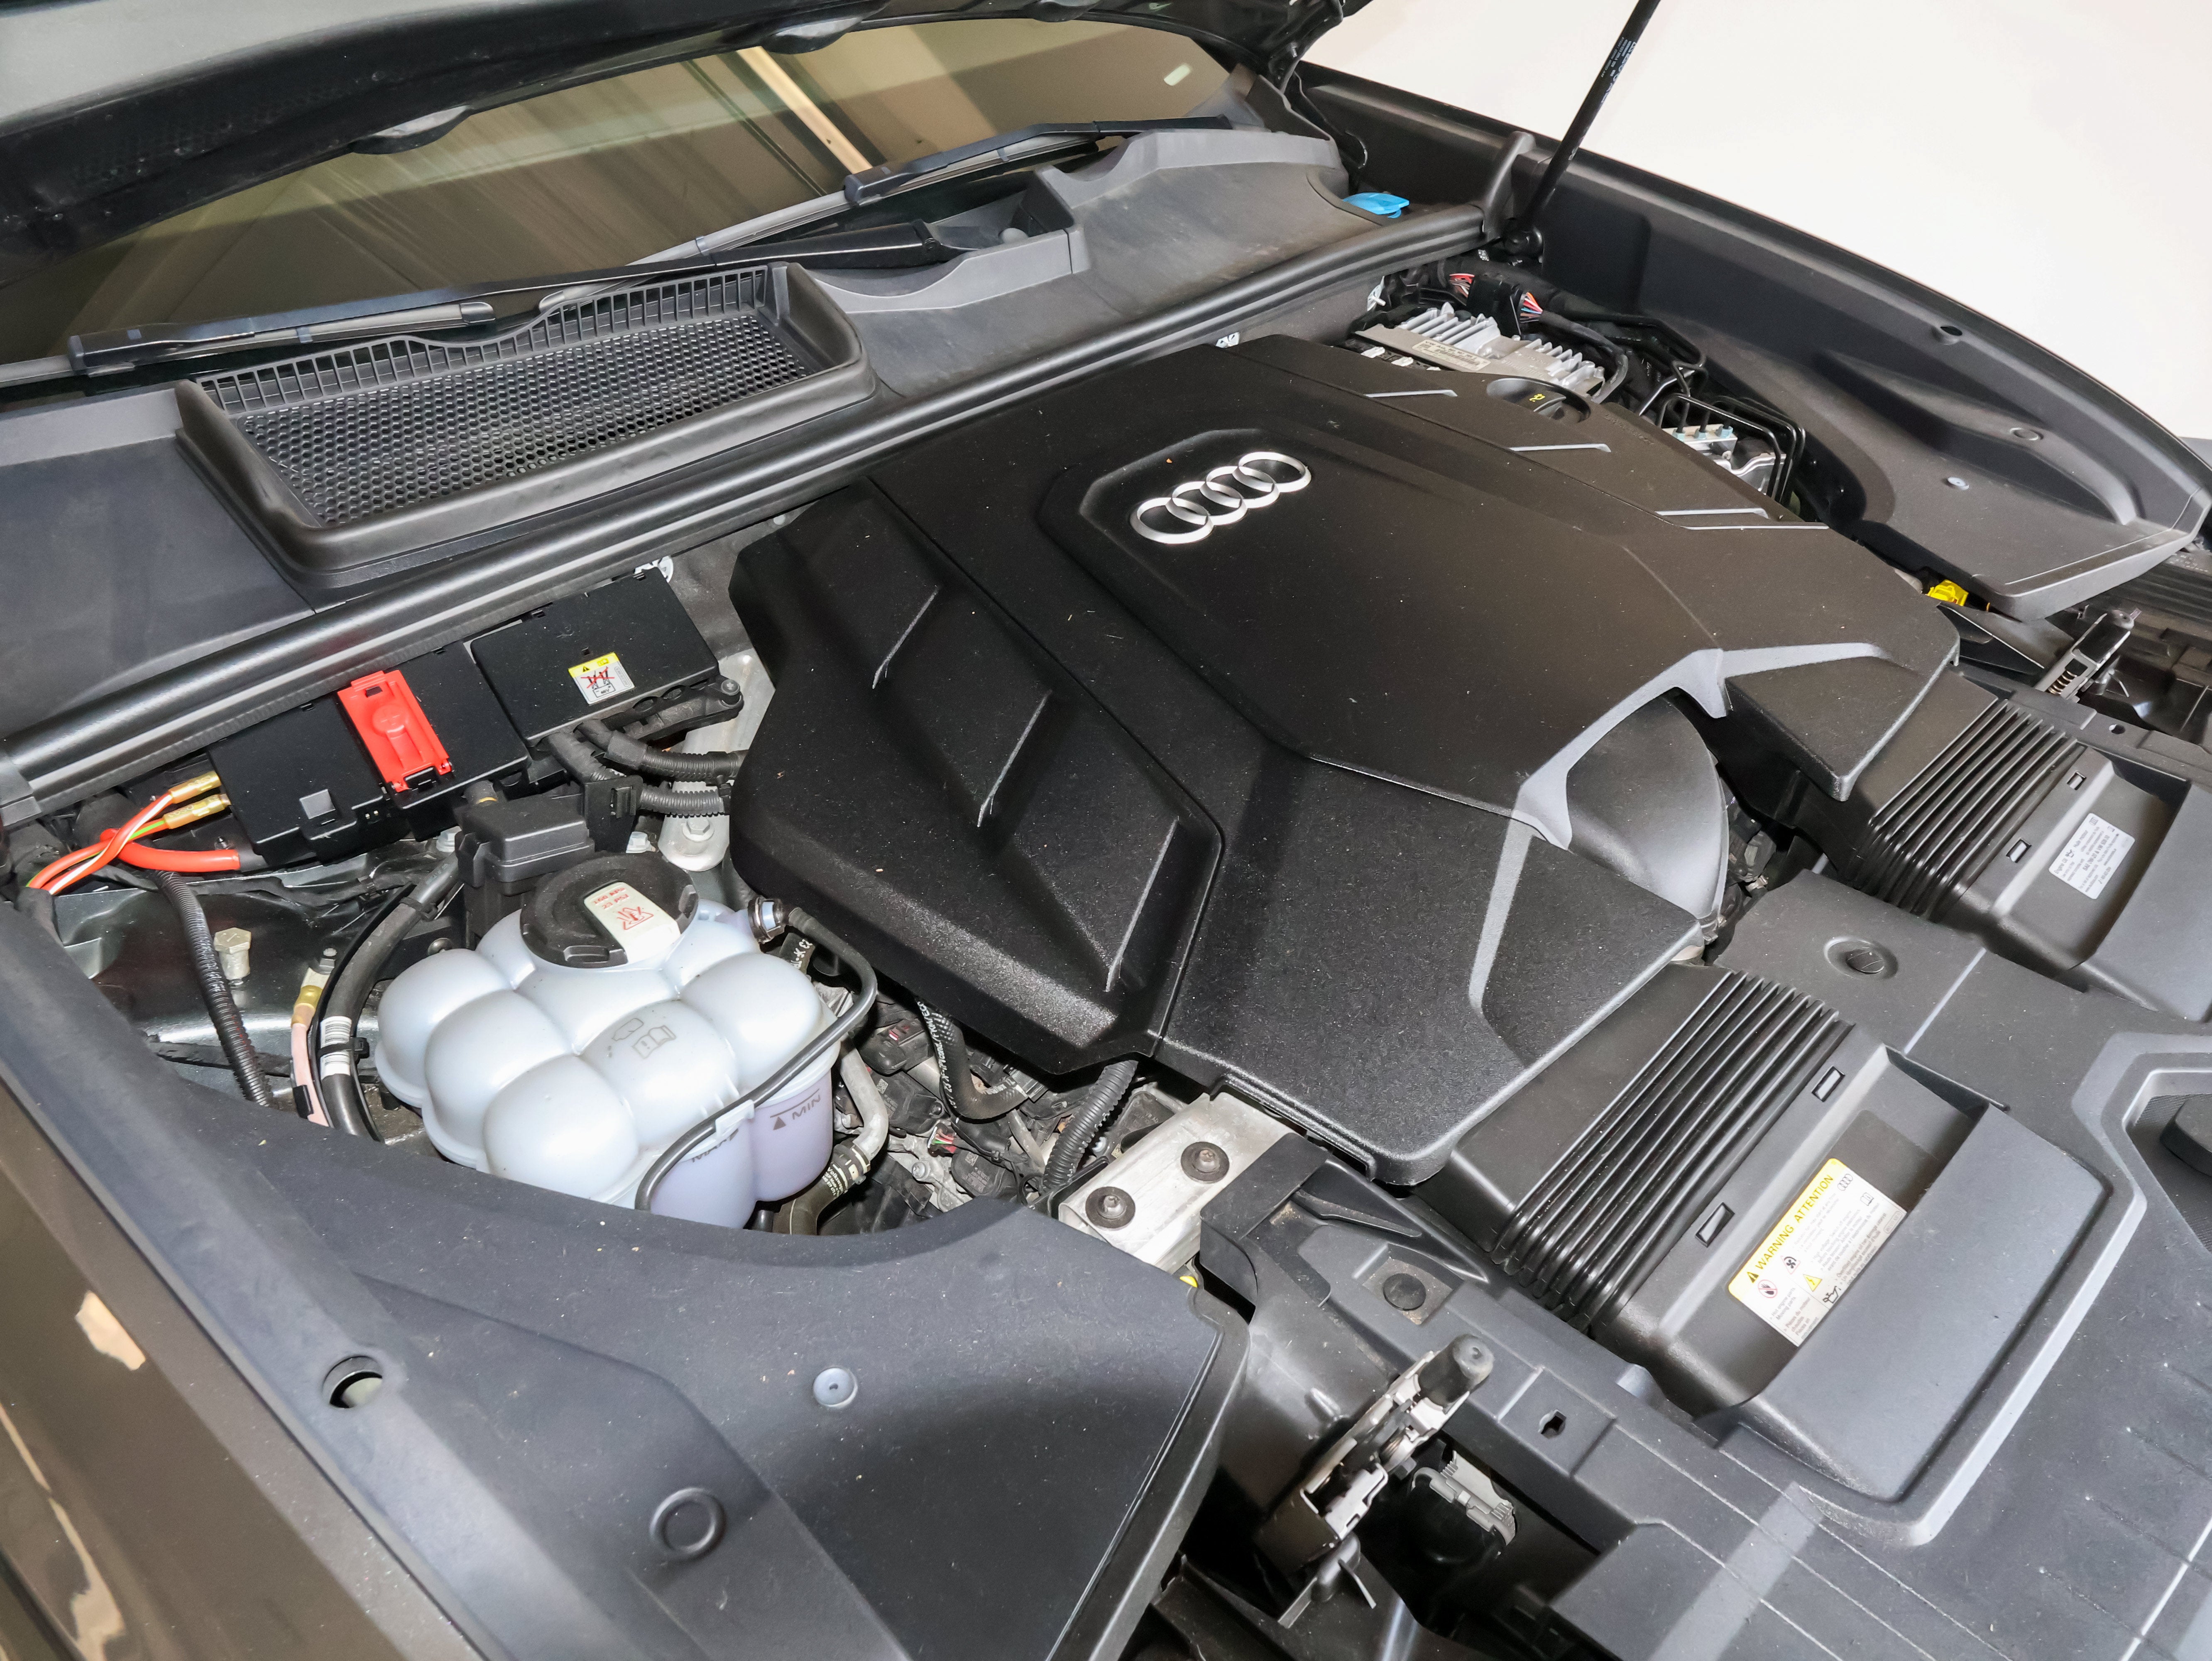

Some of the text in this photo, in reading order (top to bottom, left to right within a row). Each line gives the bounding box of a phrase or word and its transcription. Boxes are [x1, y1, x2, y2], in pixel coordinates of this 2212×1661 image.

[792, 1094, 821, 1120] MIN
[1755, 1174, 1833, 1271] WARNING ATTENTION
[1786, 1286, 1796, 1297] parts
[1786, 1296, 1796, 1306] parts
